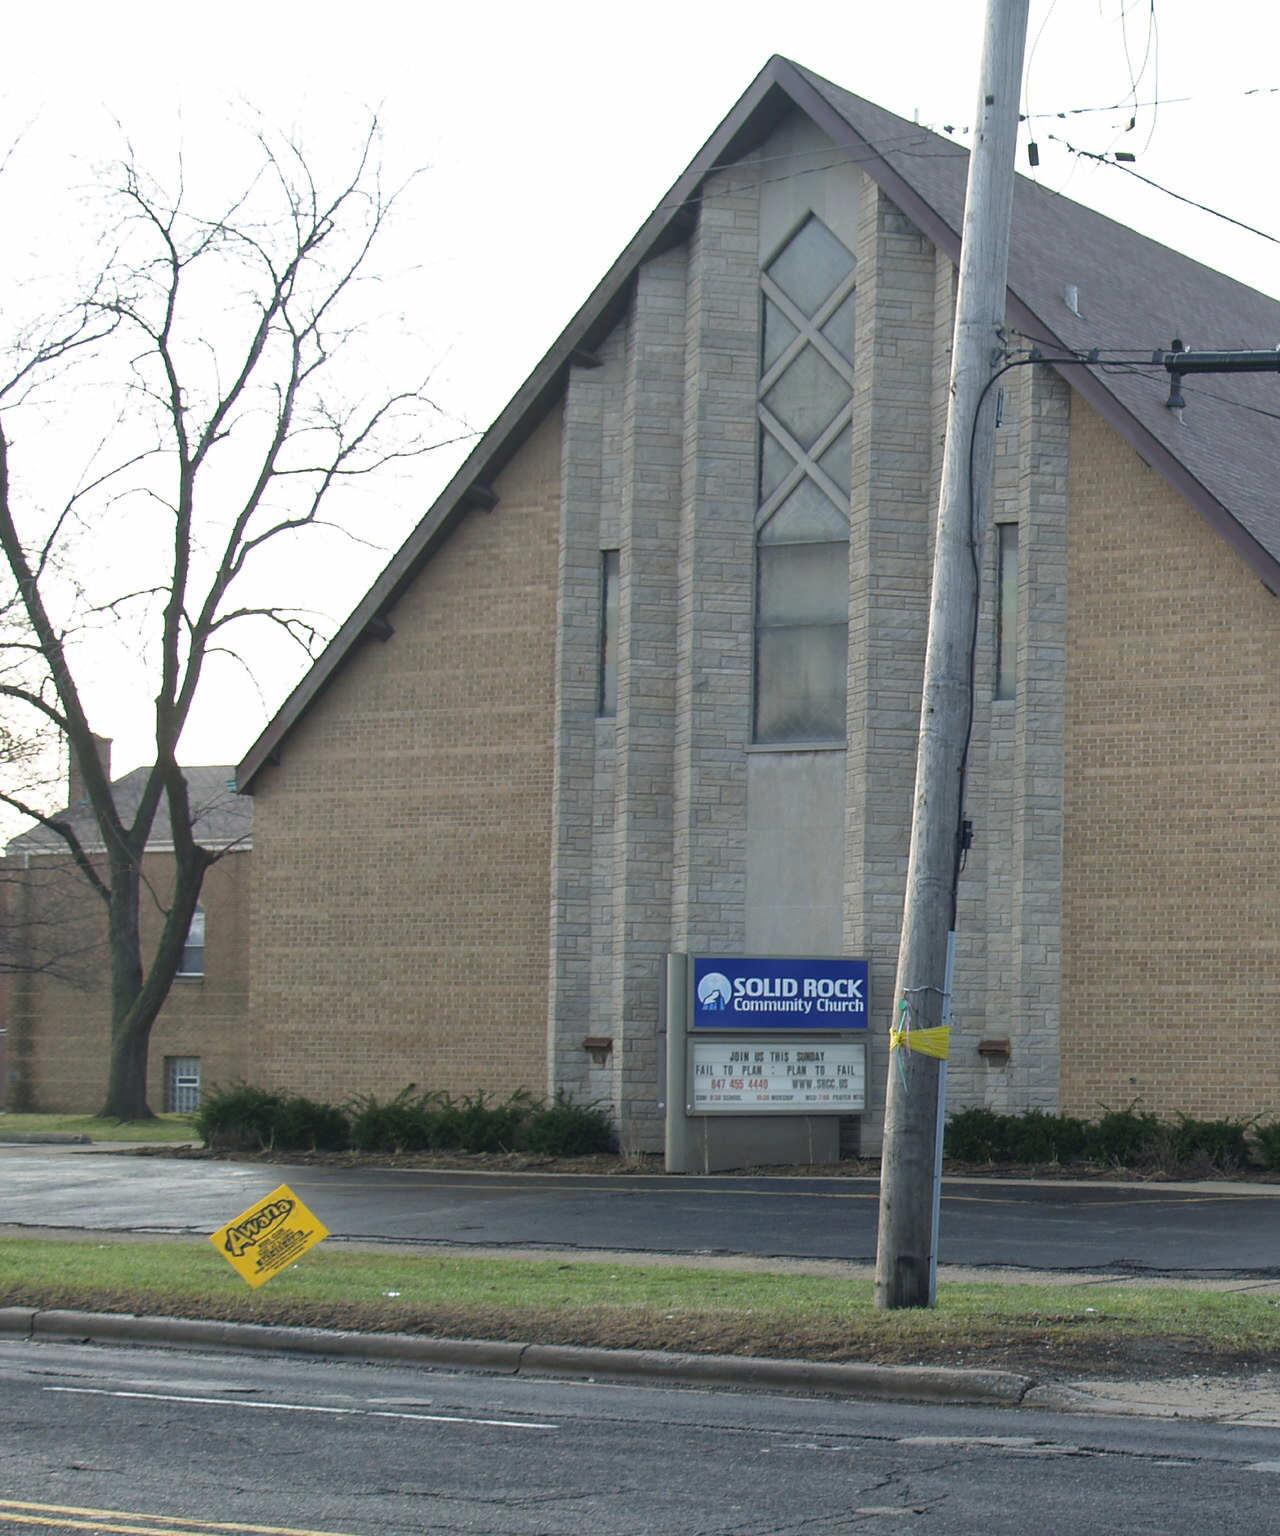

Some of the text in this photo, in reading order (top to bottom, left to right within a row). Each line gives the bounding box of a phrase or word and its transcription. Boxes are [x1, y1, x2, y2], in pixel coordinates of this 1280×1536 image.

[734, 978, 863, 998] SOLID ROCK
[734, 998, 864, 1014] Community Church
[730, 1051, 825, 1062] JOIN US THIS SUNDAY
[695, 1064, 714, 1076] FAIL
[723, 1064, 734, 1076] TO
[742, 1065, 762, 1076] PLAN
[786, 1065, 807, 1076] PLAN
[815, 1065, 825, 1076] TO
[837, 1064, 855, 1076] FAIL
[225, 1199, 293, 1256] Awana
